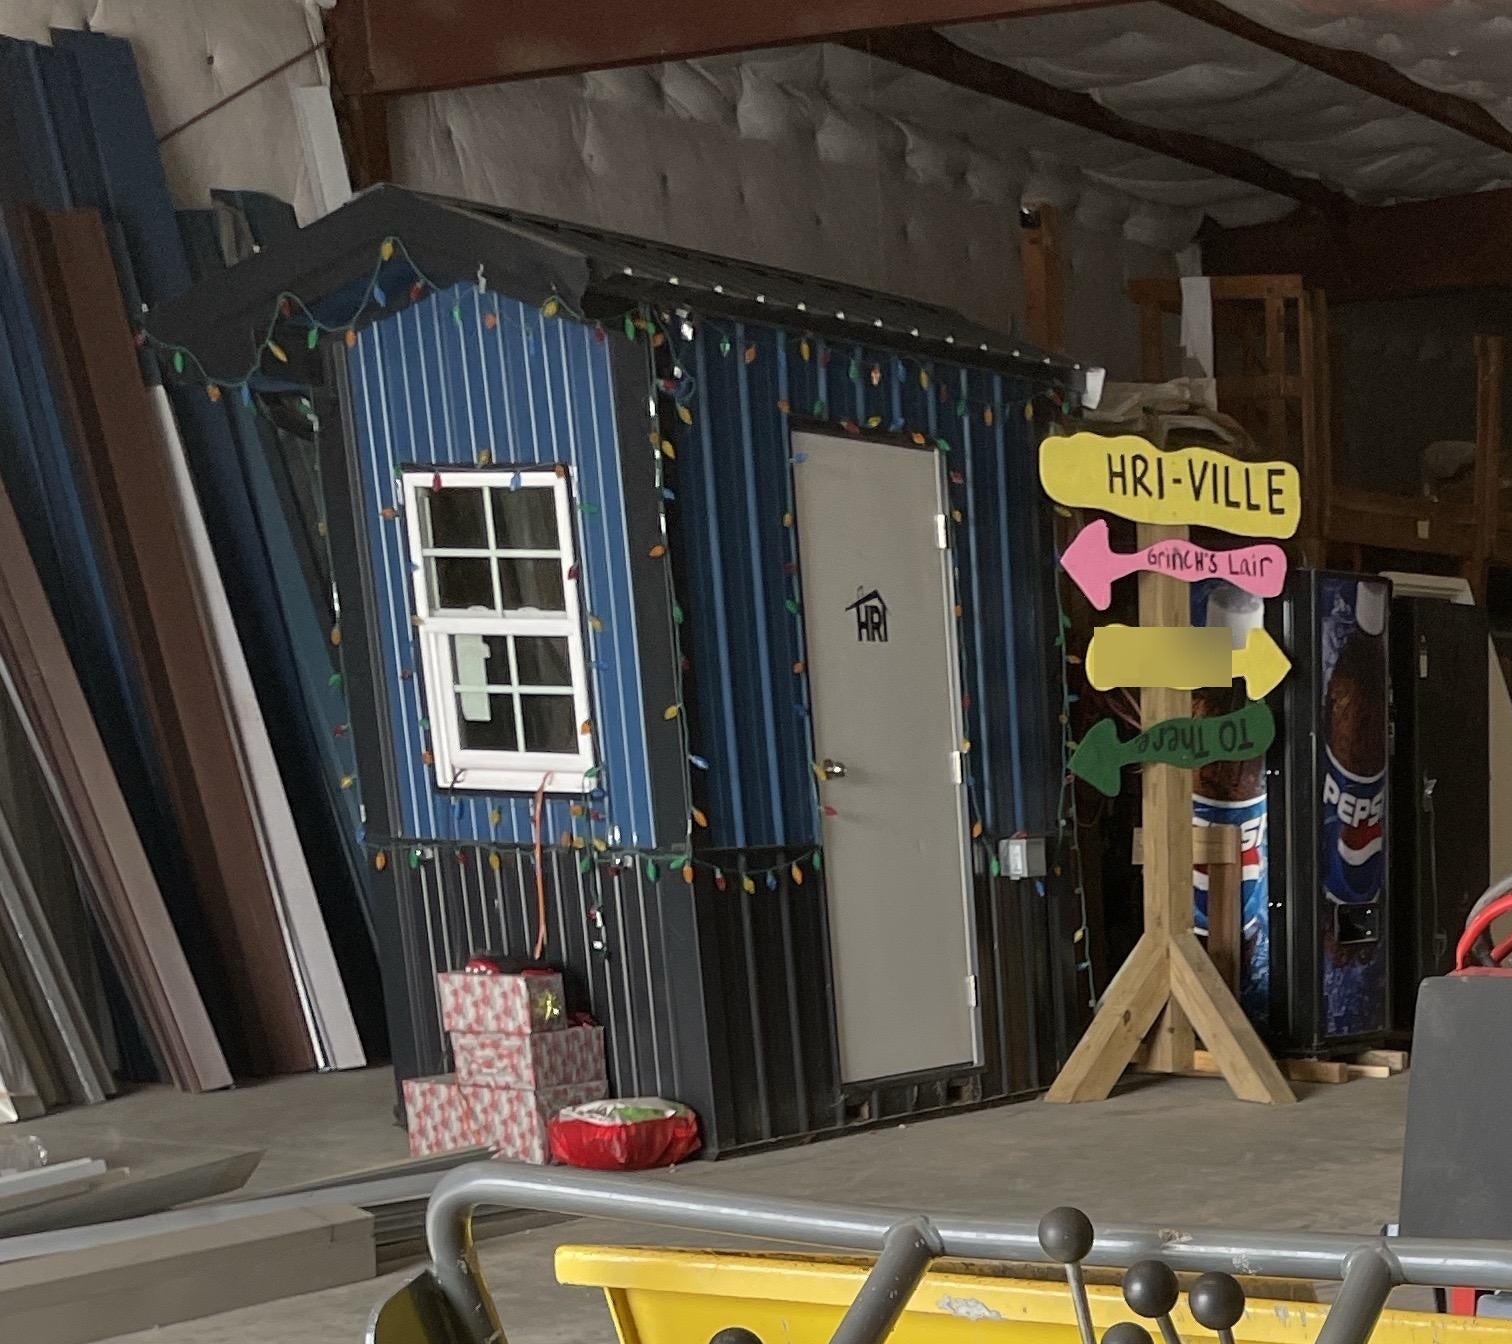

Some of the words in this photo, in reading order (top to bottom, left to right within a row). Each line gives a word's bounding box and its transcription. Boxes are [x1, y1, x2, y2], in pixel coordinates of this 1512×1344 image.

[1106, 452, 1286, 515] HRI-VILLE
[1227, 553, 1273, 577] Lair
[856, 603, 888, 642] HRI
